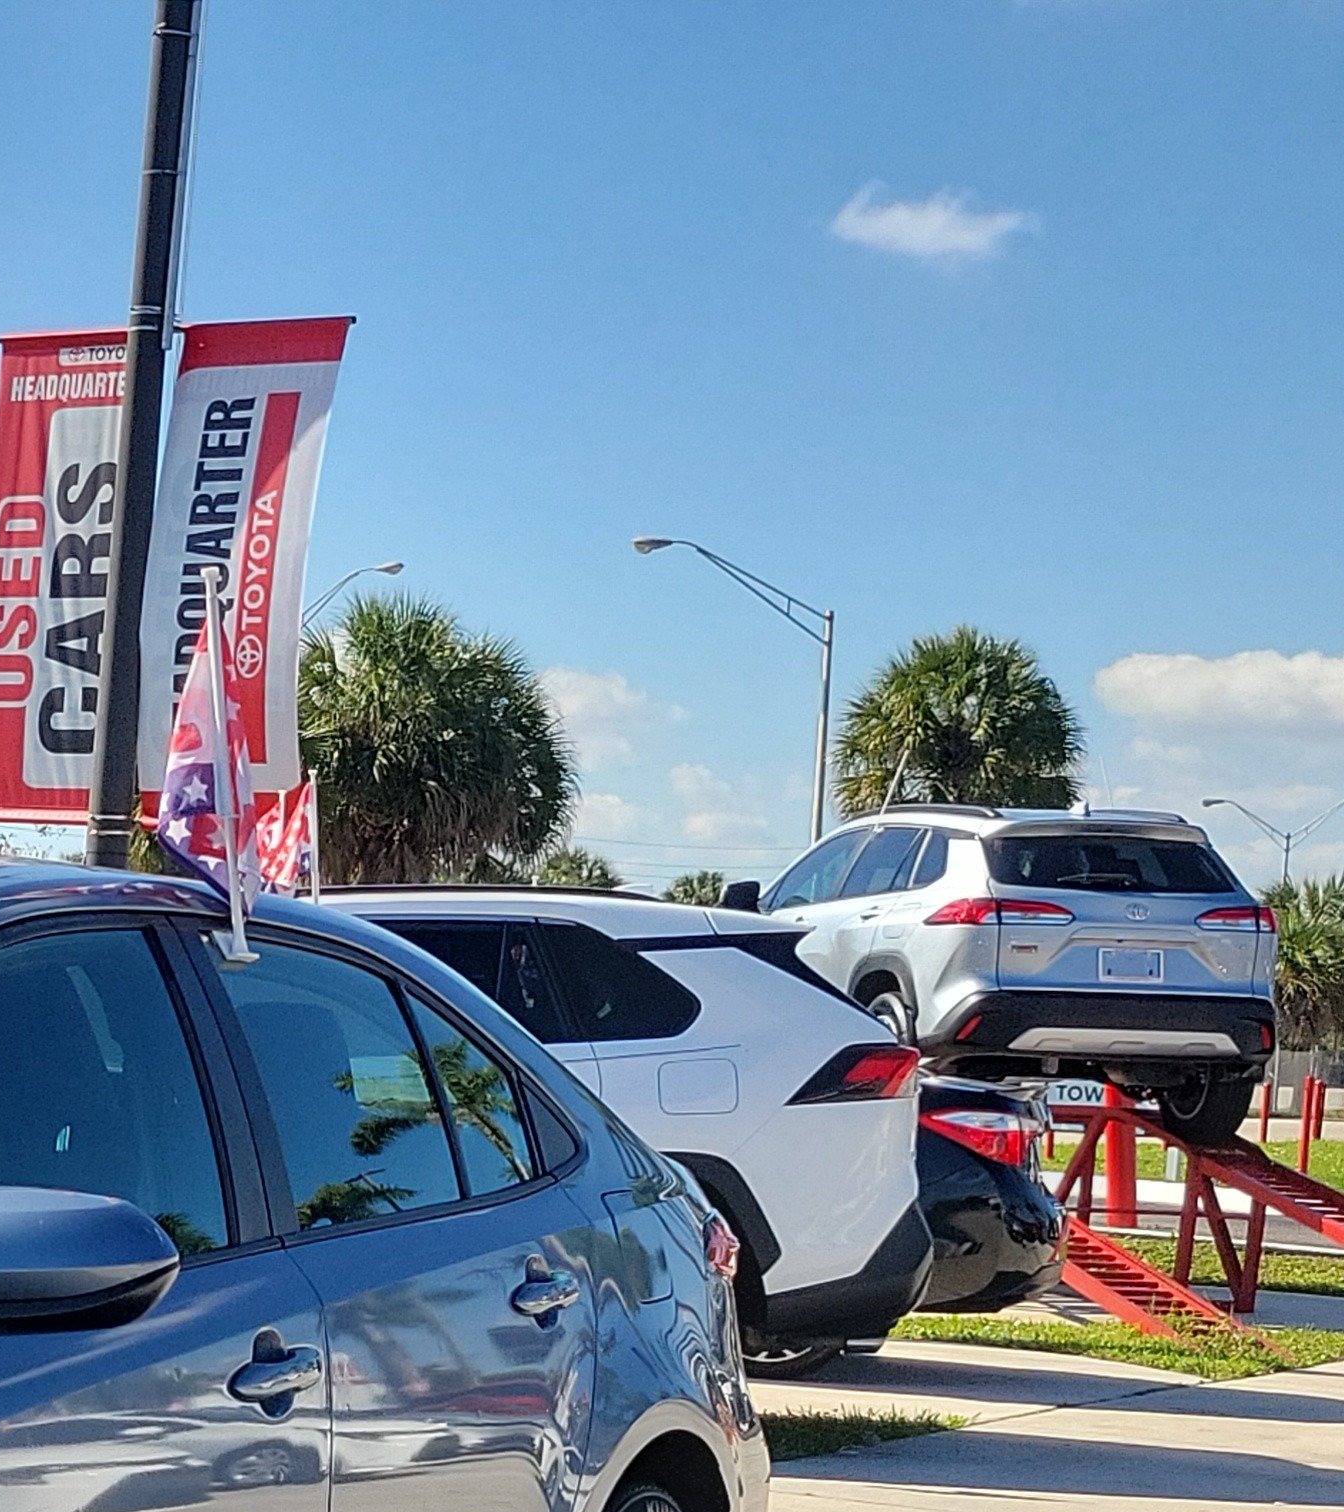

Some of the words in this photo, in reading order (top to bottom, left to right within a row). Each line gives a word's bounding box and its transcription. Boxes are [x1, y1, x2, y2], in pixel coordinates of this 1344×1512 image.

[38, 461, 118, 756] CARS
[240, 489, 278, 635] TOYOTA
[1055, 1083, 1104, 1103] TOW
